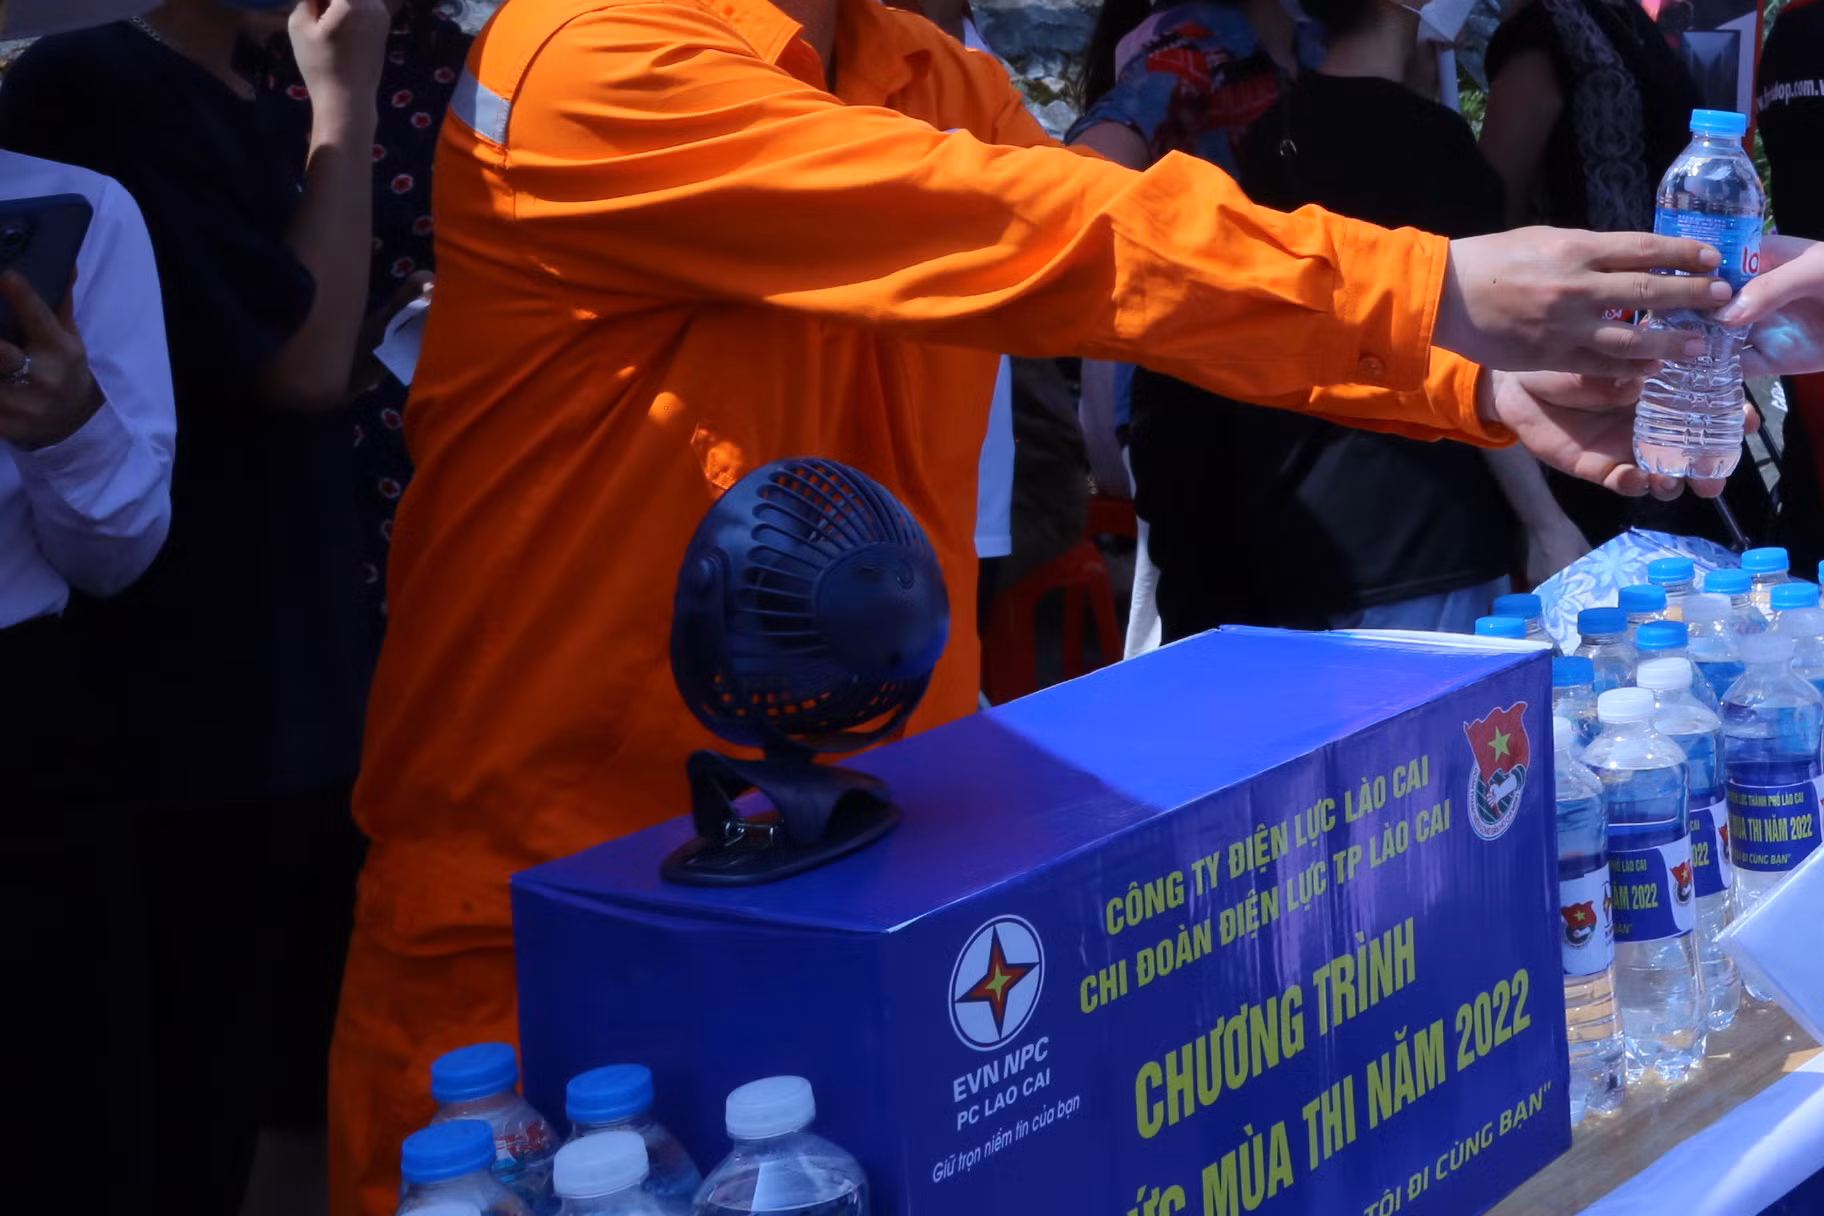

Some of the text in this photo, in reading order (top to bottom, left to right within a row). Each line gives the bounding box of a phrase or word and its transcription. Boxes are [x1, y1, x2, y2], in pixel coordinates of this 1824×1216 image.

[1106, 754, 1429, 936] CÔNG TY ĐIỆN LỰC LÀO CAI
[1790, 813, 1813, 840] 2022
[1080, 958, 1128, 1014] CHI
[1136, 918, 1213, 987] ĐOÀN
[1219, 885, 1280, 940] ĐIỆN
[1287, 861, 1327, 911] LỰC
[1333, 844, 1362, 884] TP
[1369, 820, 1409, 869] LÀO
[1416, 799, 1451, 844] CAI
[1632, 884, 1658, 910] 2022
[953, 1036, 1049, 1103] EVN NPC
[1135, 916, 1417, 1139] CHƯƠNG TRÌNH
[957, 1068, 1051, 1131] PC LAO CAI
[1201, 1120, 1294, 1216] MÙA
[1302, 1074, 1357, 1172] THI
[1366, 1018, 1446, 1130] NĂM
[1455, 968, 1531, 1072] 2022
[932, 1095, 1080, 1184] Giữ trọn niềm tin của bạn
[1407, 1166, 1429, 1201] ĐI
[1435, 1121, 1493, 1181] CÙNG
